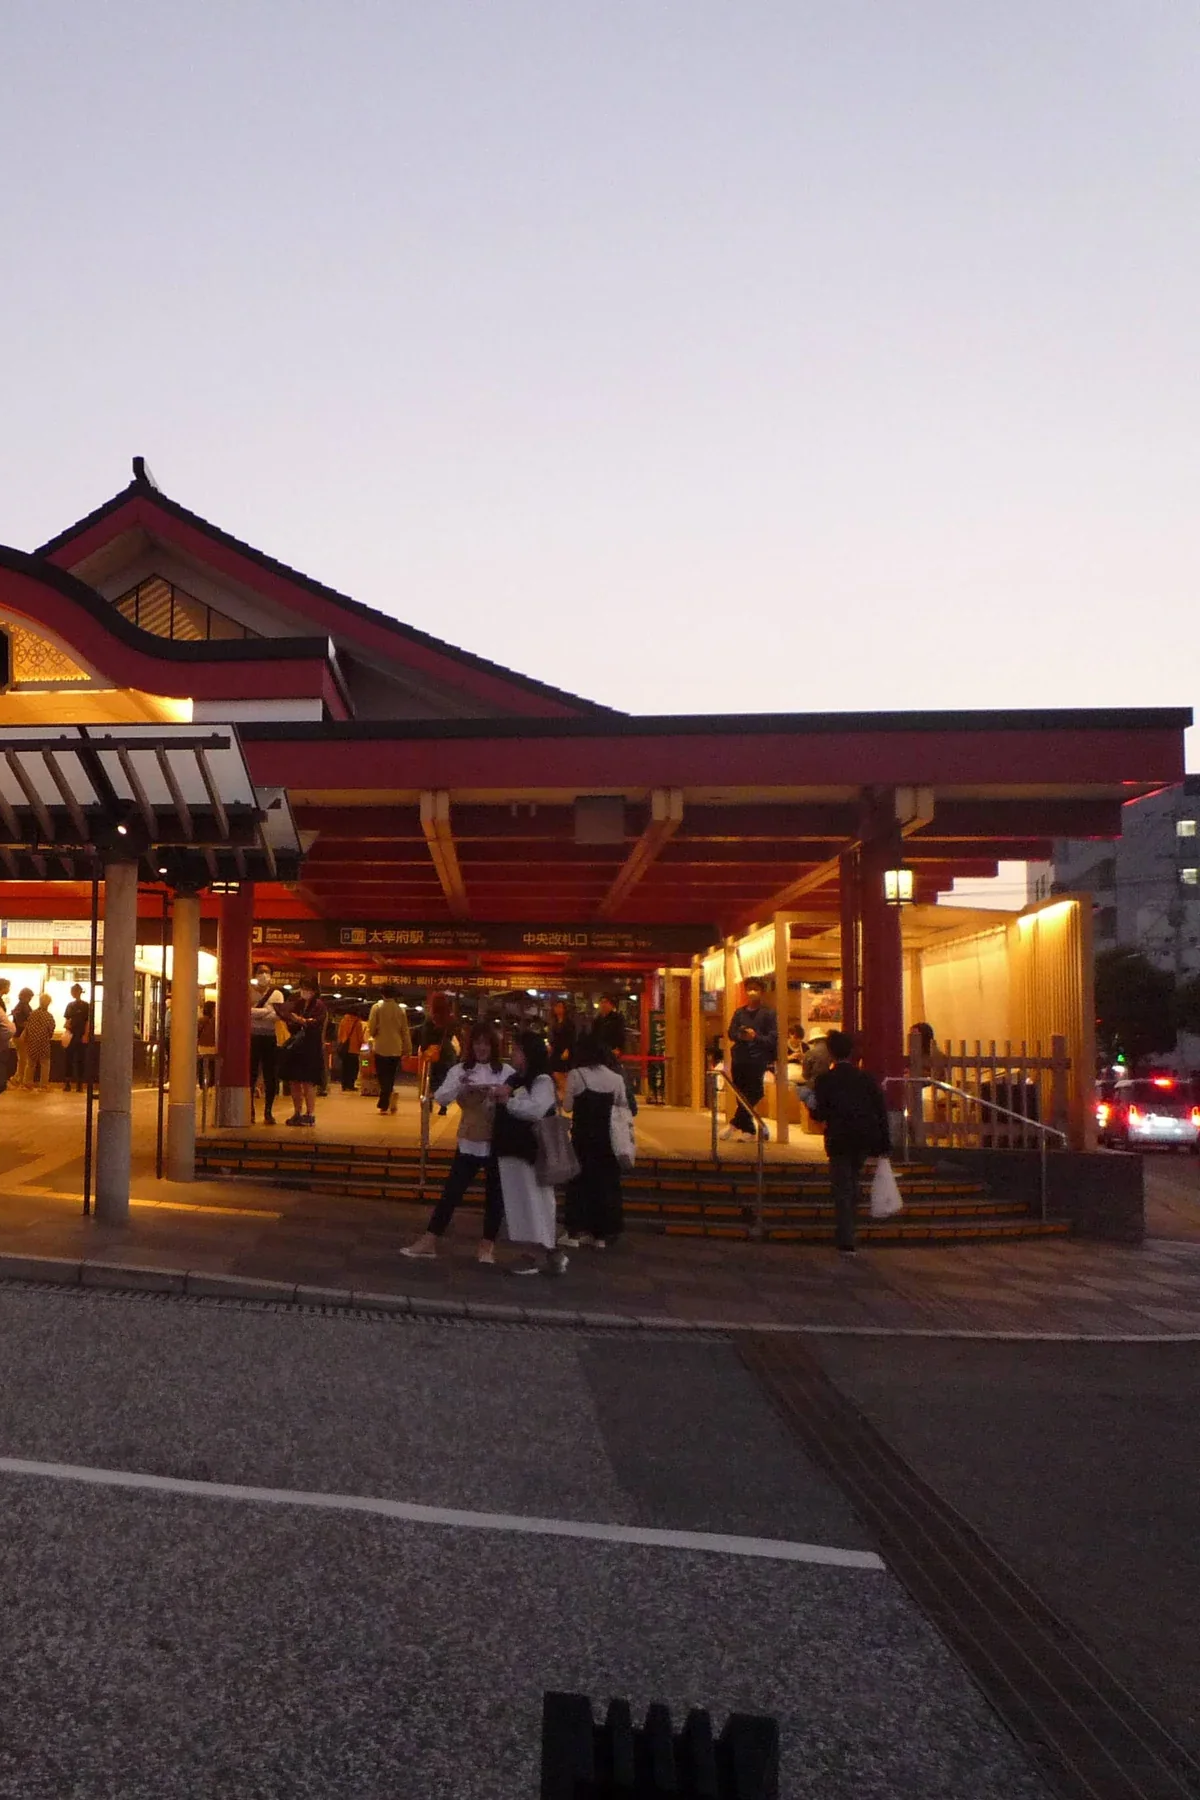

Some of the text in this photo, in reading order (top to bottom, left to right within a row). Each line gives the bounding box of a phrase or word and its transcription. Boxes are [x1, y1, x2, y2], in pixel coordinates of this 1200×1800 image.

[368, 930, 424, 944] 太宰府駅
[522, 931, 588, 946] 中央改札口
